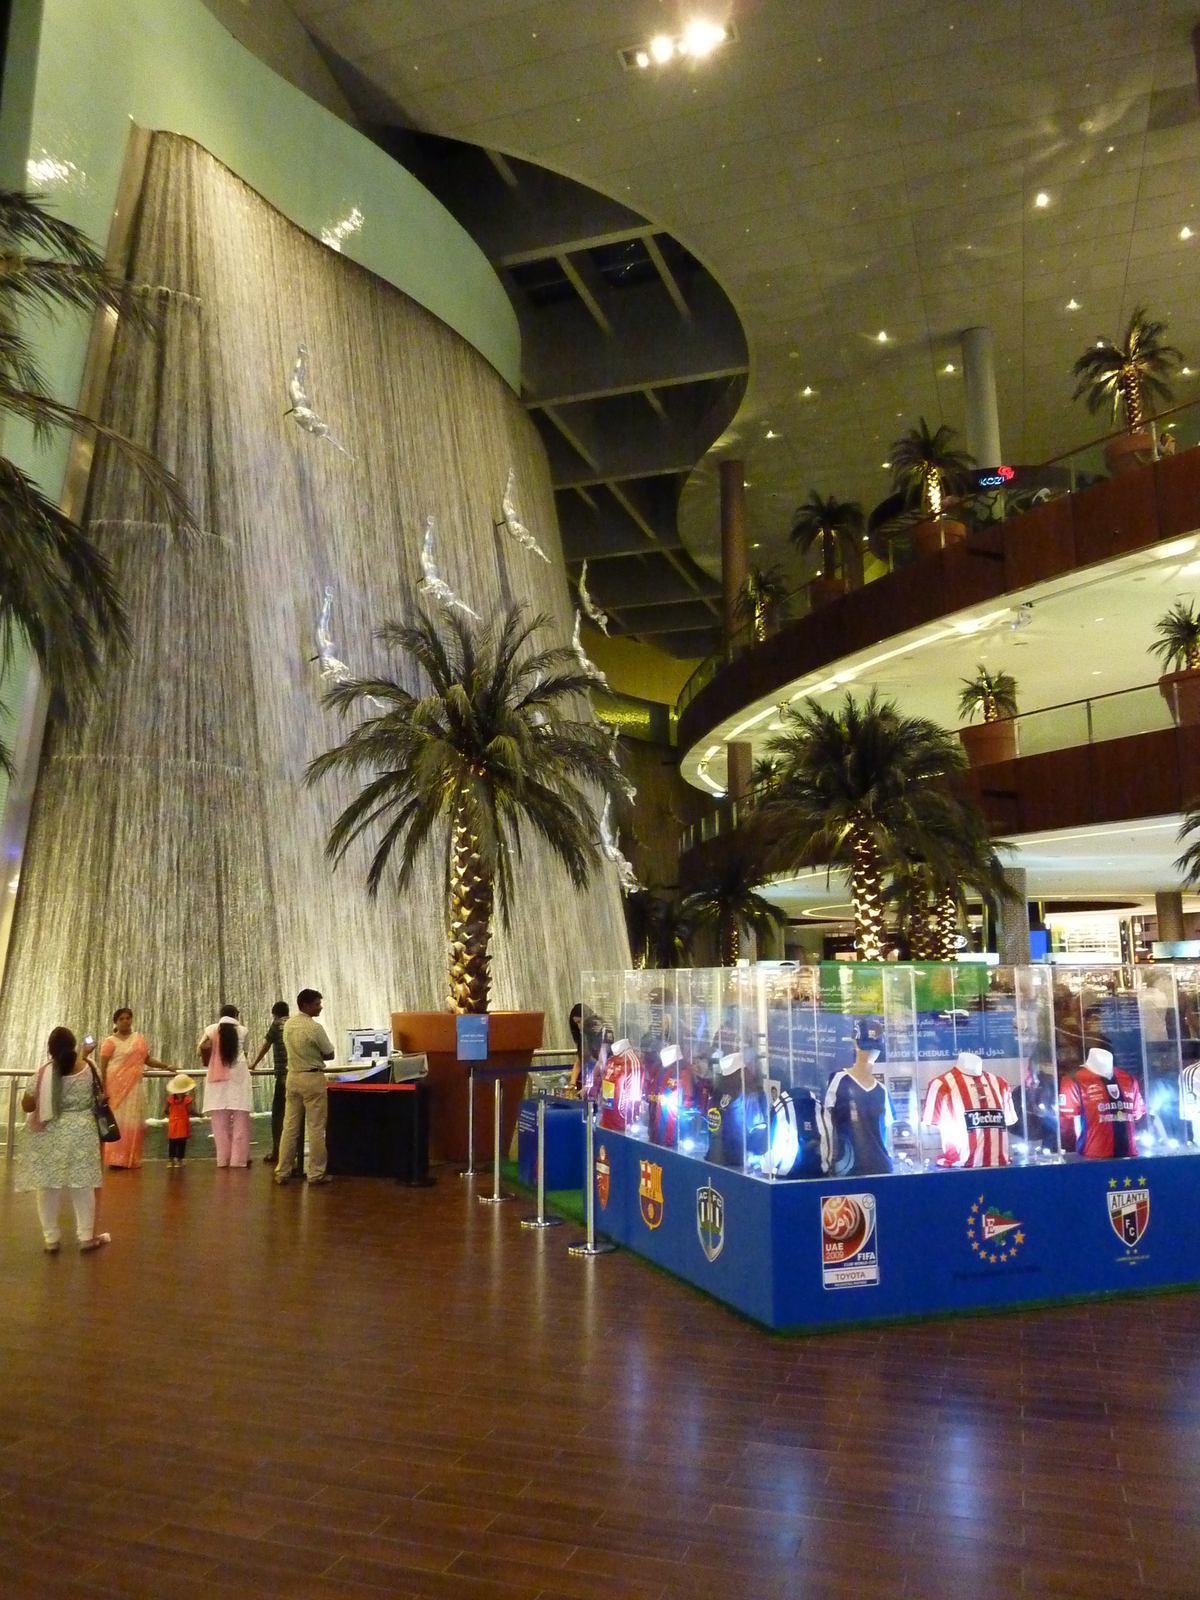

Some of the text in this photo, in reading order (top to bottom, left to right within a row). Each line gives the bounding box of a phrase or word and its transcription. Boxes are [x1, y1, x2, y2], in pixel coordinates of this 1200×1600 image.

[698, 1191, 708, 1201] AC
[712, 1194, 722, 1207] FC
[1111, 1192, 1146, 1209] ATLANTE
[825, 1242, 844, 1252] UAE
[825, 1251, 845, 1260] 2009
[857, 1251, 876, 1261] FIFA
[835, 1271, 867, 1281] TOYOTA
